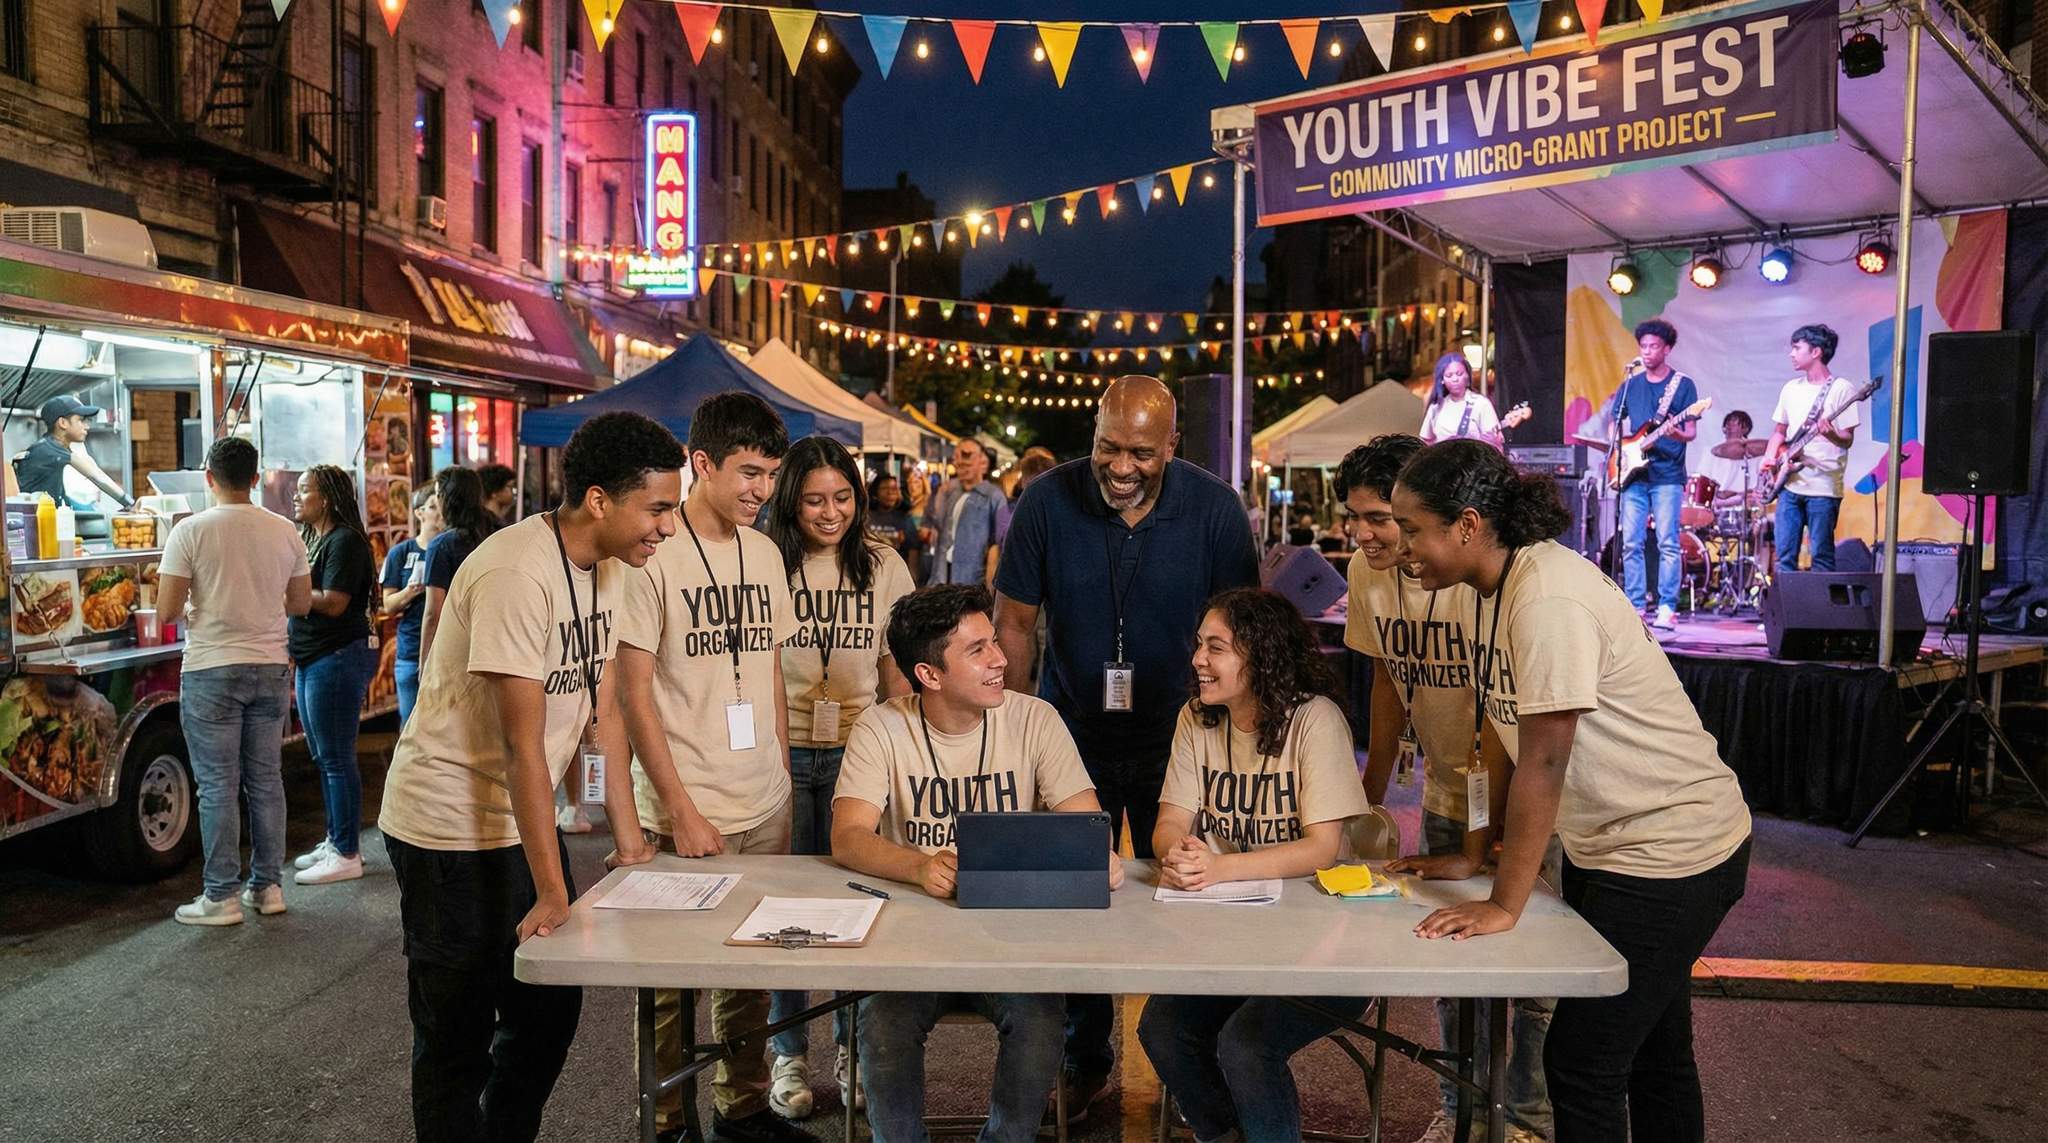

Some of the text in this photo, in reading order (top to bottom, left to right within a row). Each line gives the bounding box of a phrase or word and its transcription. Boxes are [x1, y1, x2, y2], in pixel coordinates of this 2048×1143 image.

[1283, 15, 1789, 168] YOUTH VIBE FEST
[1330, 106, 1726, 198] COMMUNITY MICRO-GRANT PROJECT
[681, 584, 772, 629] YOUTH
[795, 589, 874, 625] OUTH
[685, 626, 774, 658] ORGANIZER
[781, 625, 875, 650] GANIZER
[1375, 616, 1467, 661] YOUTH
[1384, 657, 1470, 689] RGANIZER
[908, 770, 1018, 819] YOUTH
[1202, 765, 1298, 816] YOUTH
[1200, 808, 1304, 845] ORGANIZER
